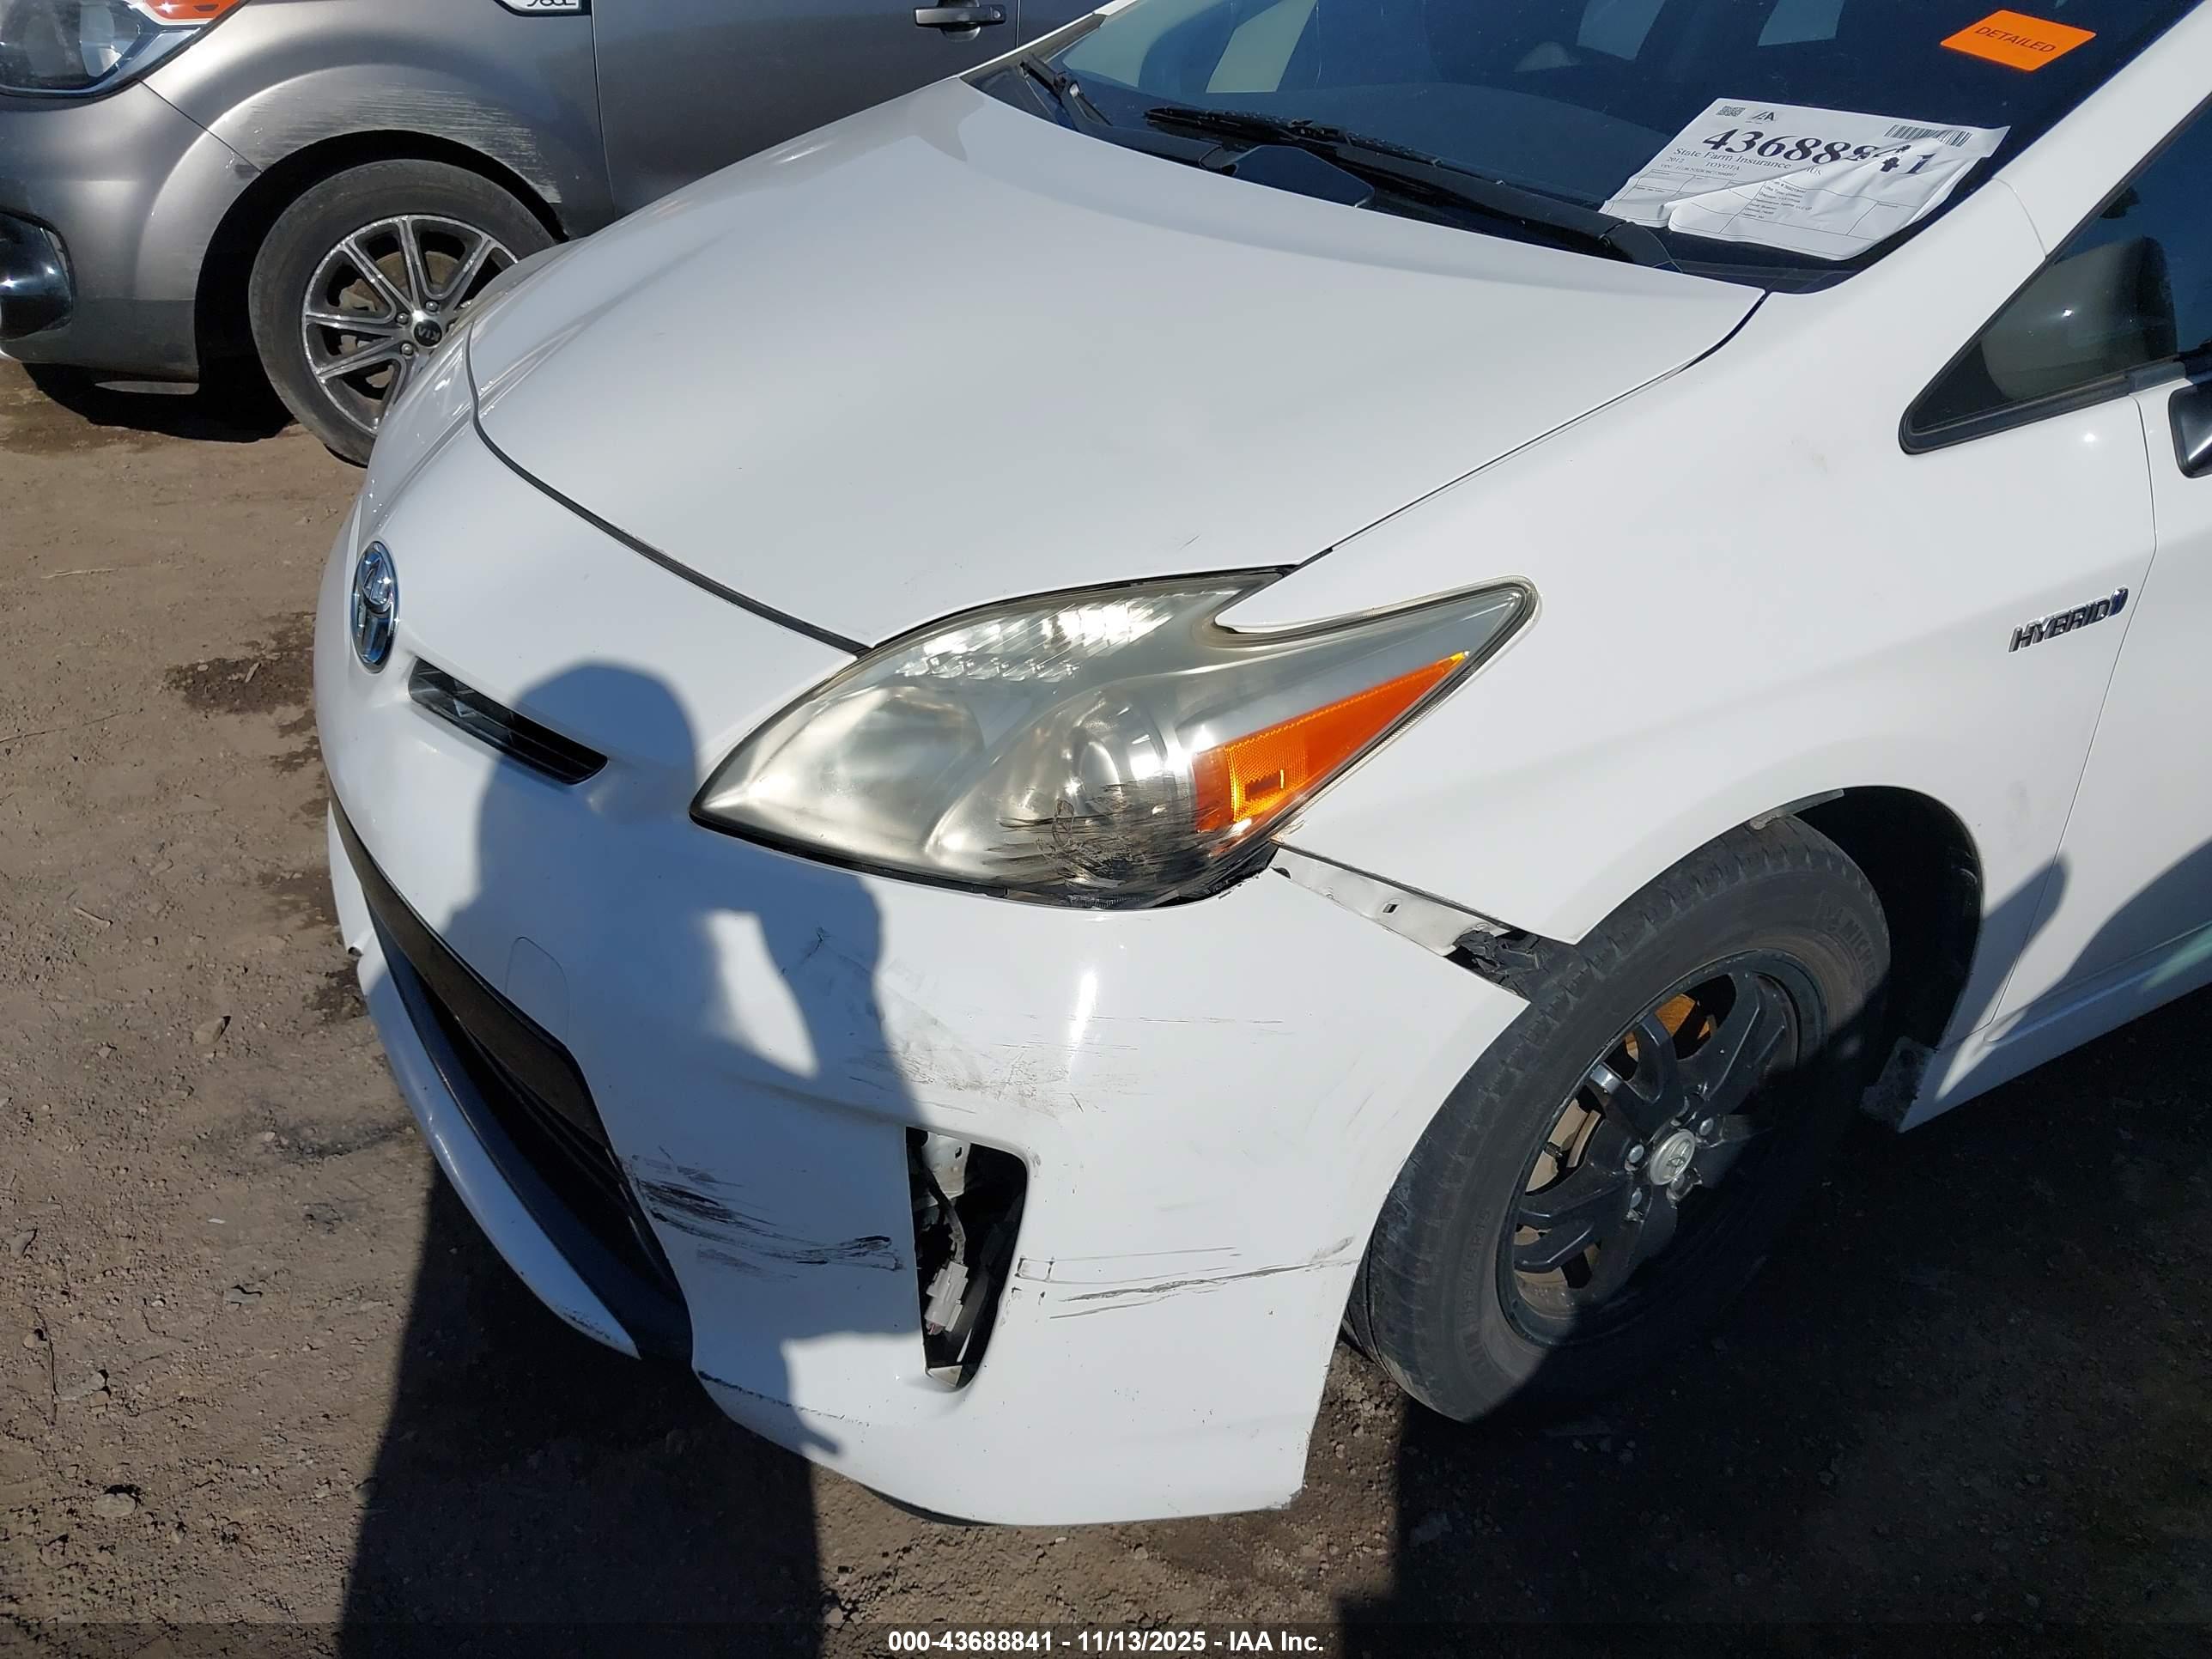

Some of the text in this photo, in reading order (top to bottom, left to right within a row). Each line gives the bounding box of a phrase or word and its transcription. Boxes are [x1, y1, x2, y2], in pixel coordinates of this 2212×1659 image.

[1974, 27, 2056, 53] DETAILED
[1674, 148, 1792, 169] State Farm Insurance
[1705, 161, 1741, 172] TOYOTA
[2008, 596, 2111, 653] HYBRID
